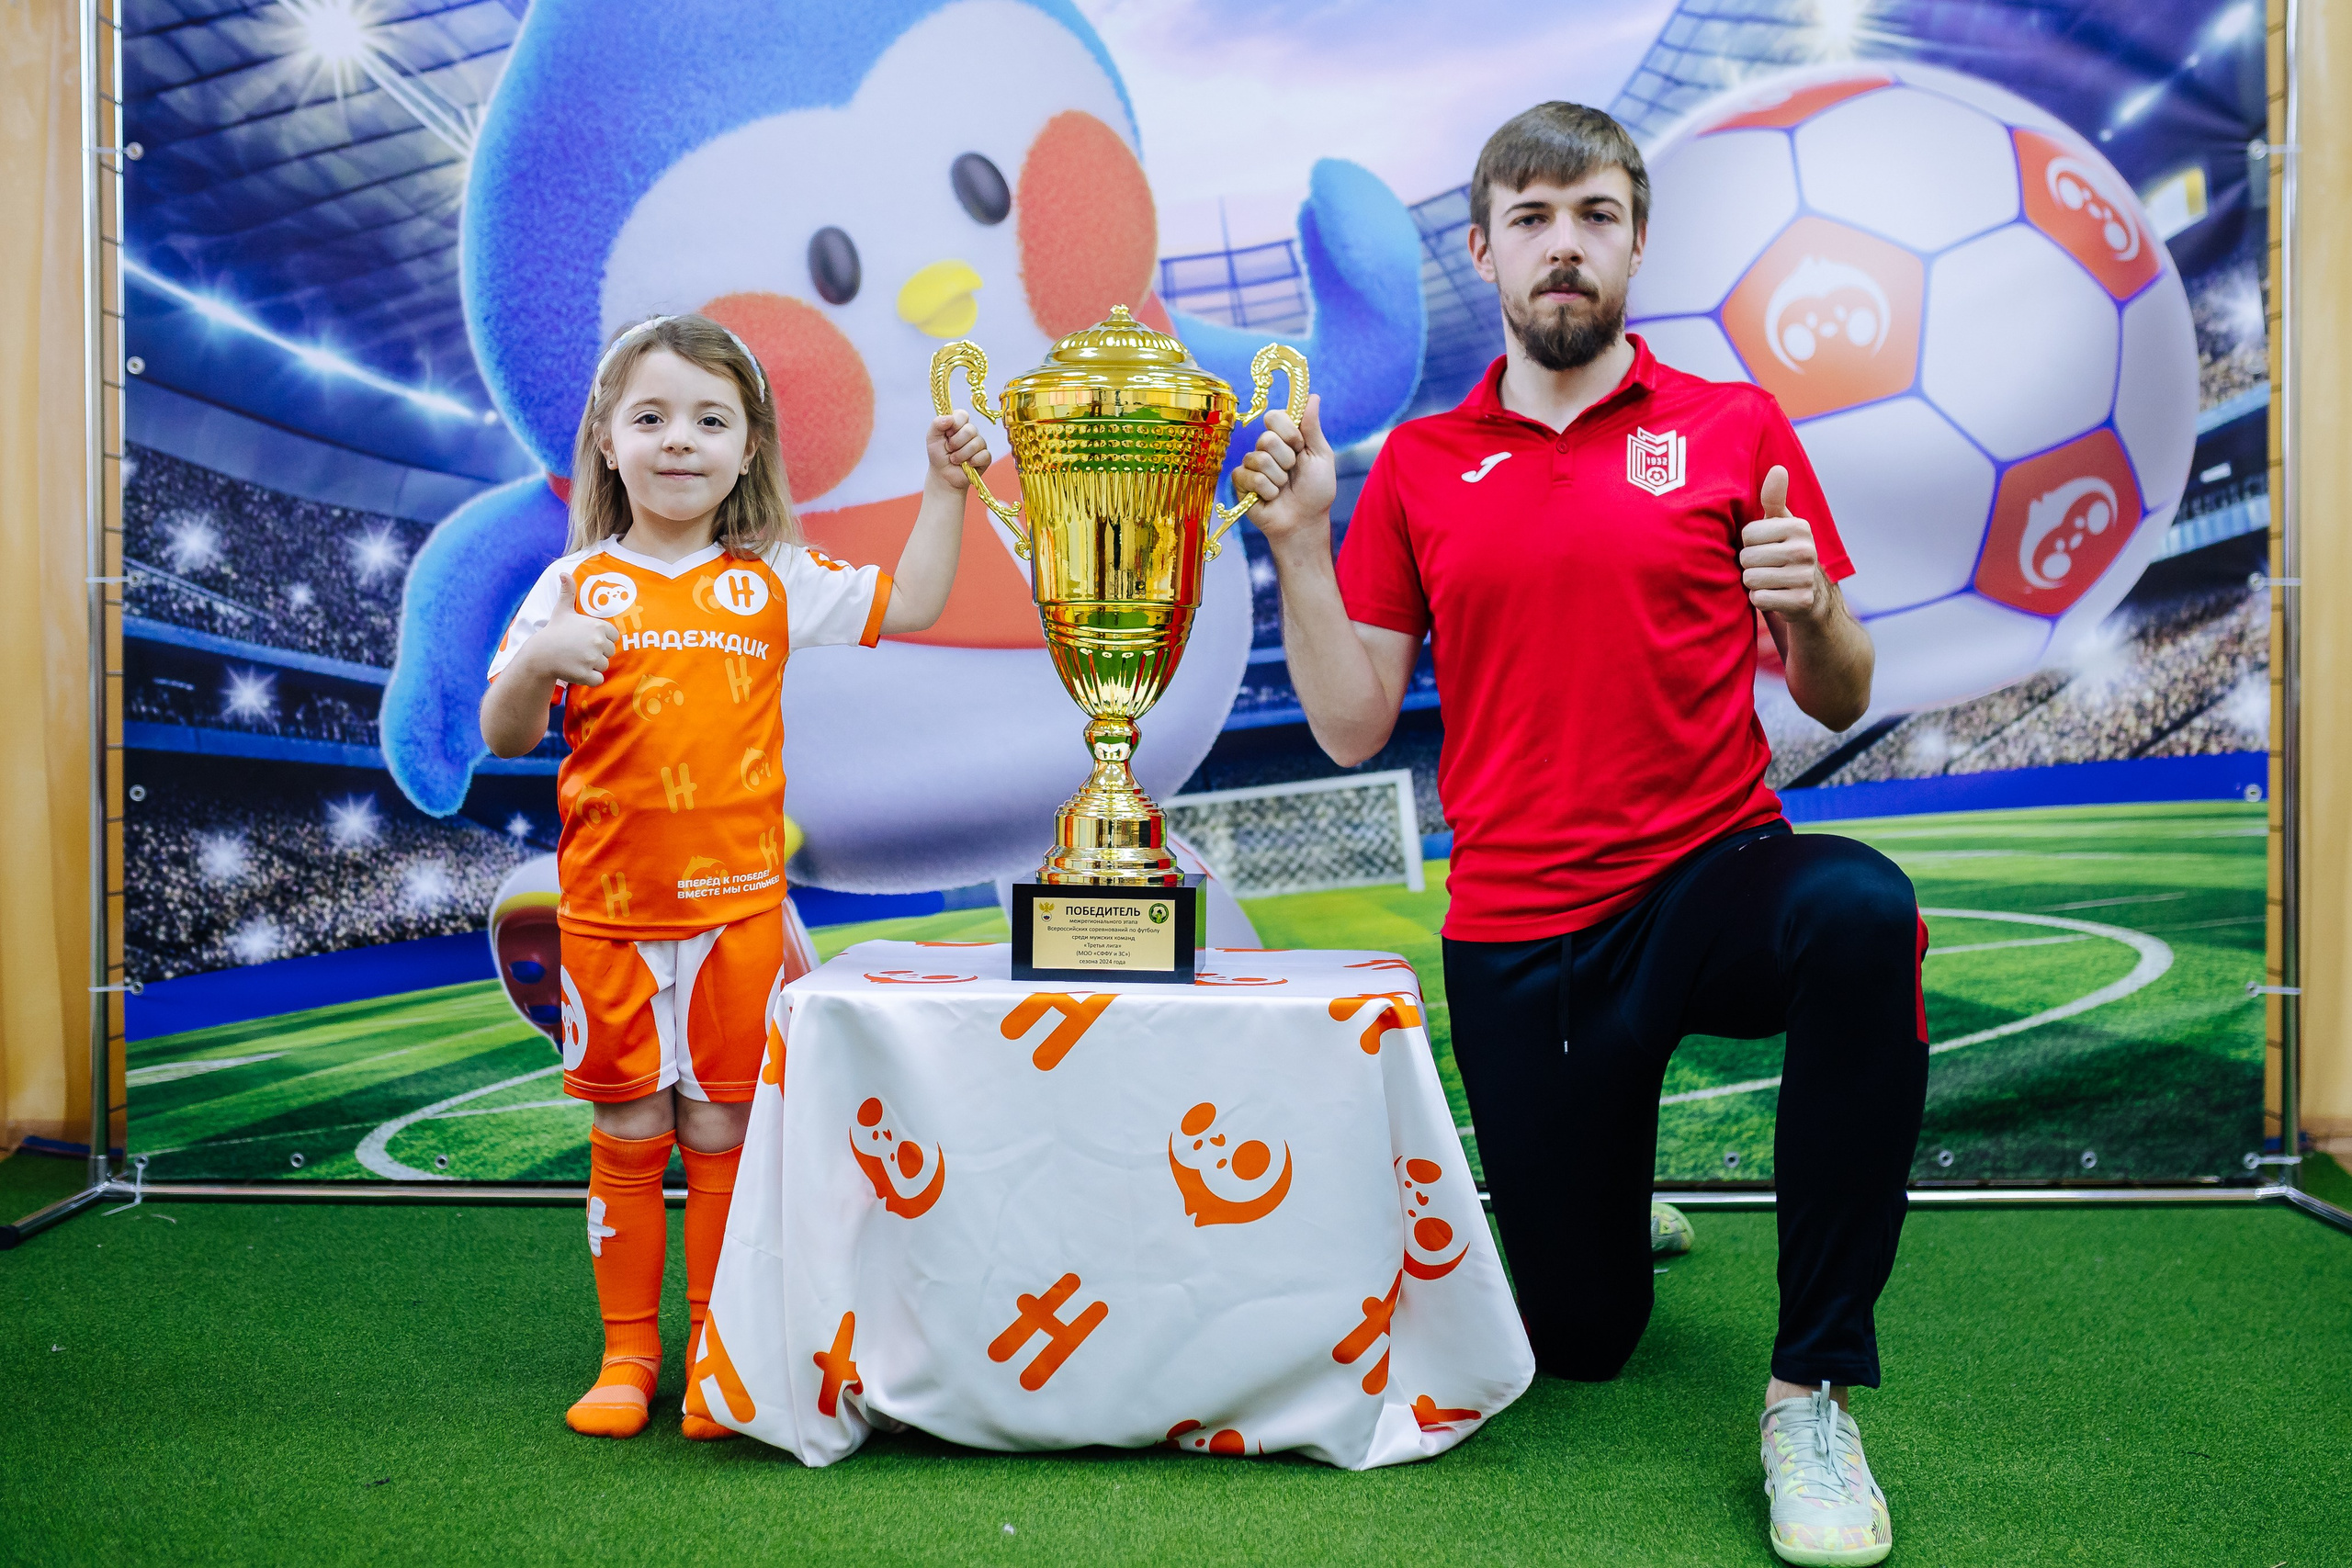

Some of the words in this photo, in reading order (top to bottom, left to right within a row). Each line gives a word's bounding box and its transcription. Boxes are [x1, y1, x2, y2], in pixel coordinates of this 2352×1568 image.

[1646, 457, 1668, 466] 1932
[622, 629, 770, 660] НАДЕЖДИК
[677, 875, 721, 889] ВПЕРЁД
[722, 876, 730, 886] К
[732, 868, 770, 884] ПОБЕДЕ!
[677, 887, 721, 899] ВМЕСТЕ
[722, 885, 741, 896] МЫ
[742, 874, 780, 893] СИЛЬНЕЕ!
[1066, 906, 1141, 918] ПОБЕДИТЕЛЬ
